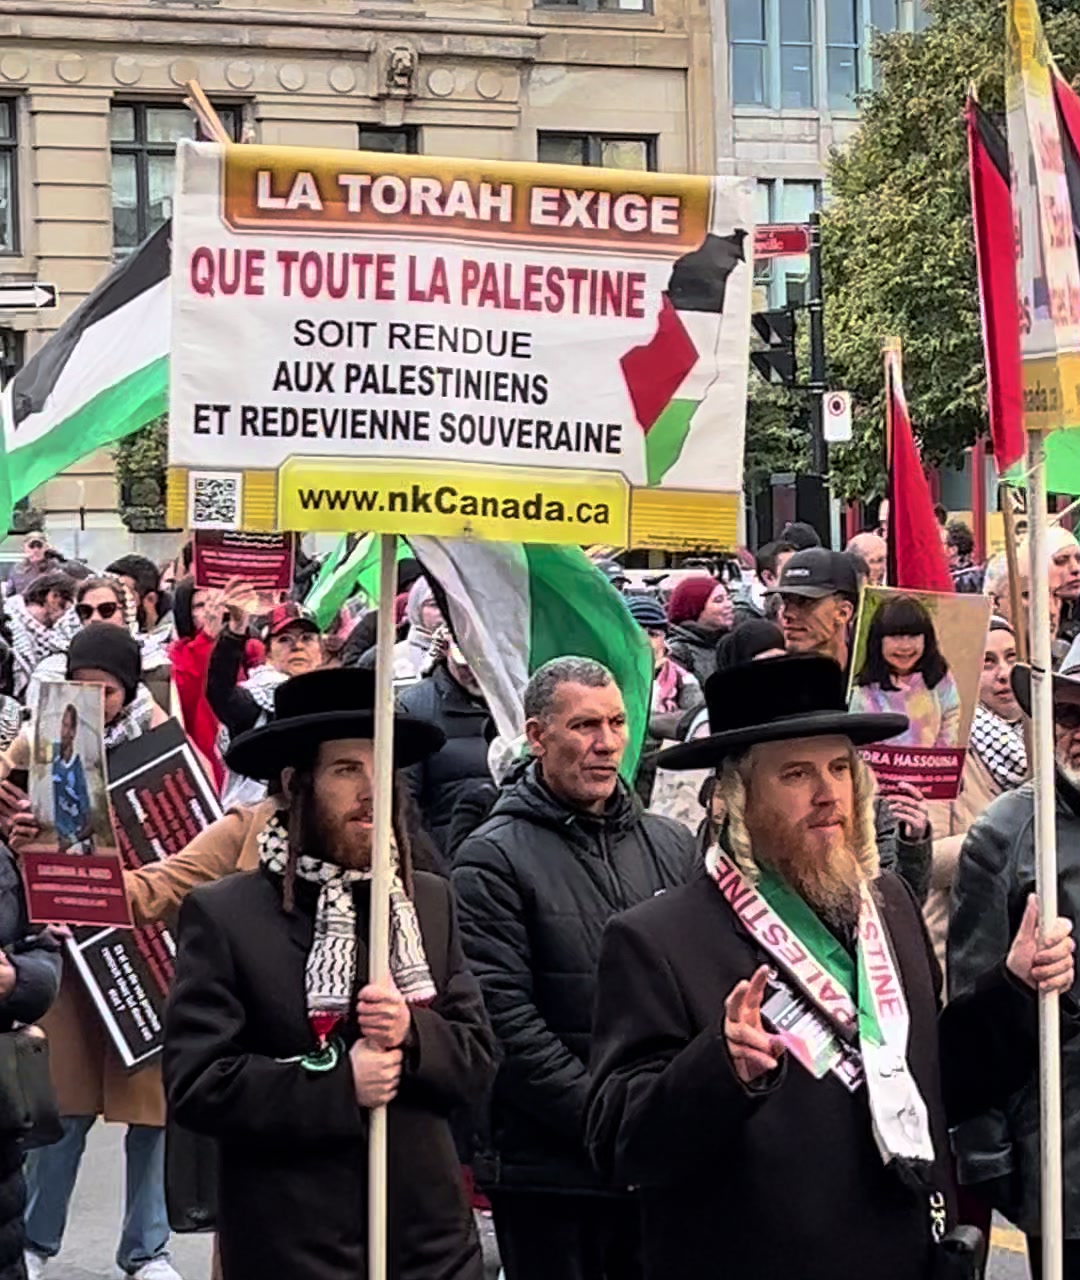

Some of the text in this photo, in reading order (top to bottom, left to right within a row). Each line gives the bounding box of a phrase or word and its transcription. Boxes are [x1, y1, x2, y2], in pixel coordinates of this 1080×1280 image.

[257, 171, 680, 234] LA TORAH EXIGE
[191, 246, 645, 318] QUE TOUTE LA PALESTINE
[294, 319, 532, 359] SOIT RENDUE
[273, 361, 548, 405] AUX PALESTINIENS
[194, 404, 622, 455] ET REDEVIENNE SOUVERAINE
[298, 486, 610, 525] www.nkCanada.ca
[715, 856, 852, 1028] PALESTINE
[859, 898, 904, 1018] ESTINE
